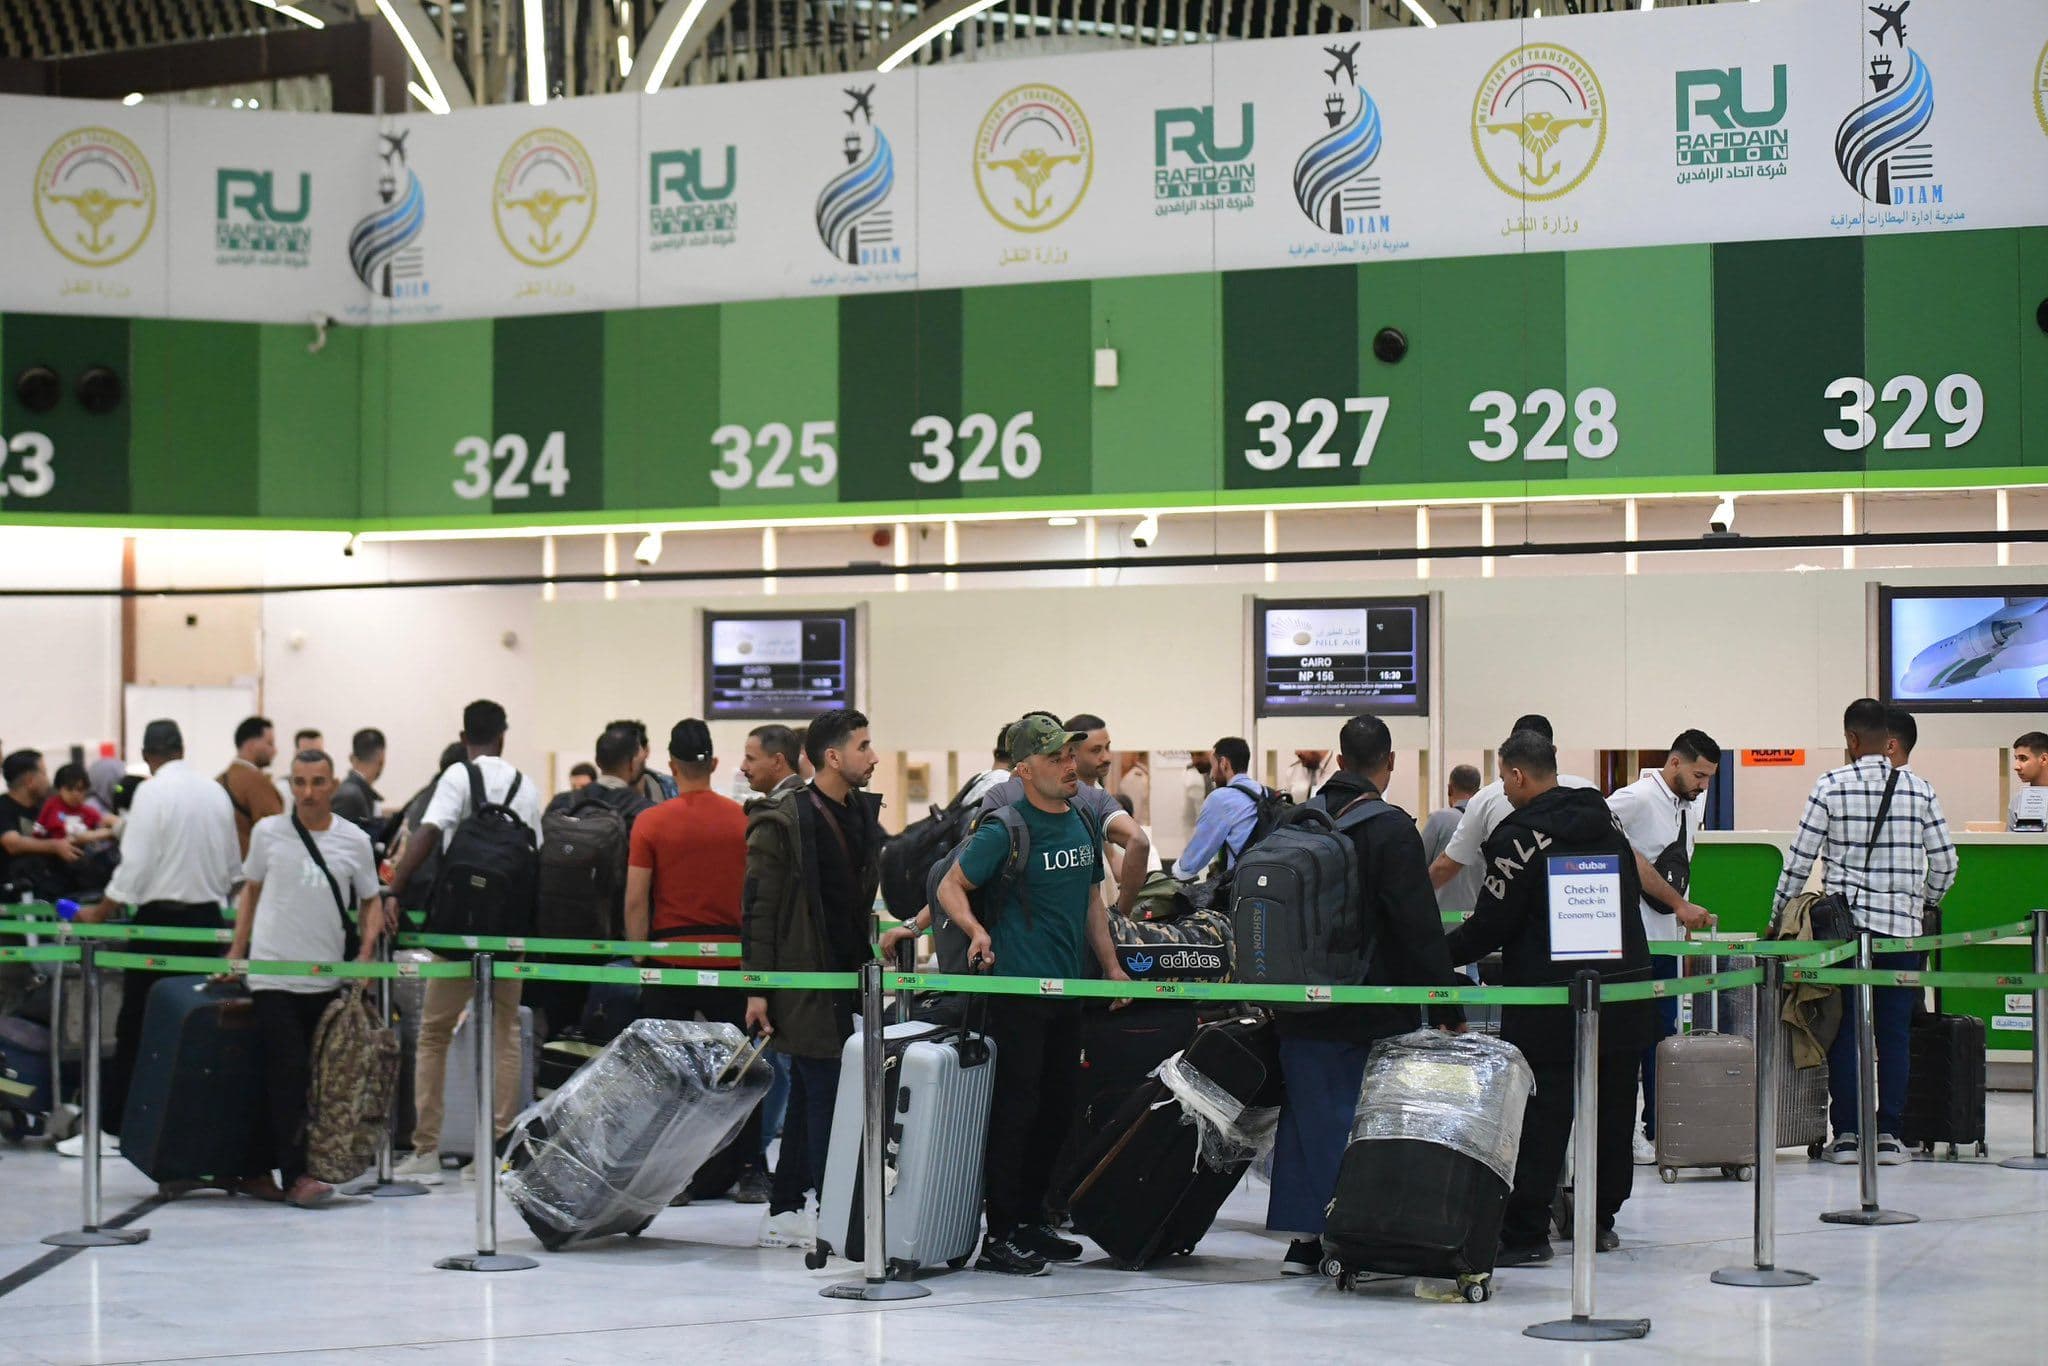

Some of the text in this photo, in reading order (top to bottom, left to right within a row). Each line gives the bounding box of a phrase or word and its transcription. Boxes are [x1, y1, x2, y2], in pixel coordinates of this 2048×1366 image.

[1527, 49, 1601, 117] TRANSPORTATION
[1675, 64, 1788, 132] RU
[1155, 102, 1255, 166] RU
[1675, 129, 1788, 150] RAFIDAIN
[1676, 145, 1789, 166] UNION
[650, 145, 736, 205] RU
[1155, 163, 1255, 184] RAFIDAIN
[1676, 161, 1787, 184] شركة اتحاد الرافدين
[217, 168, 311, 222] RU
[1155, 179, 1255, 199] UNION
[1893, 184, 1943, 205] DIAM
[1345, 215, 1390, 234] DIAM
[1500, 215, 1579, 236] وزارة النقل
[1822, 373, 1985, 452] 329
[1244, 396, 1390, 471] 327
[1468, 387, 1619, 462] 328
[710, 421, 838, 489] 325
[909, 411, 1042, 484] 326
[452, 431, 569, 500] 324
[1300, 657, 1332, 667] CAIRO
[1298, 671, 1314, 682] NP
[1564, 884, 1609, 894] Check-in
[1568, 897, 1606, 905] Check-in
[1558, 910, 1617, 920] Economy Class
[1160, 951, 1221, 969] adidas
